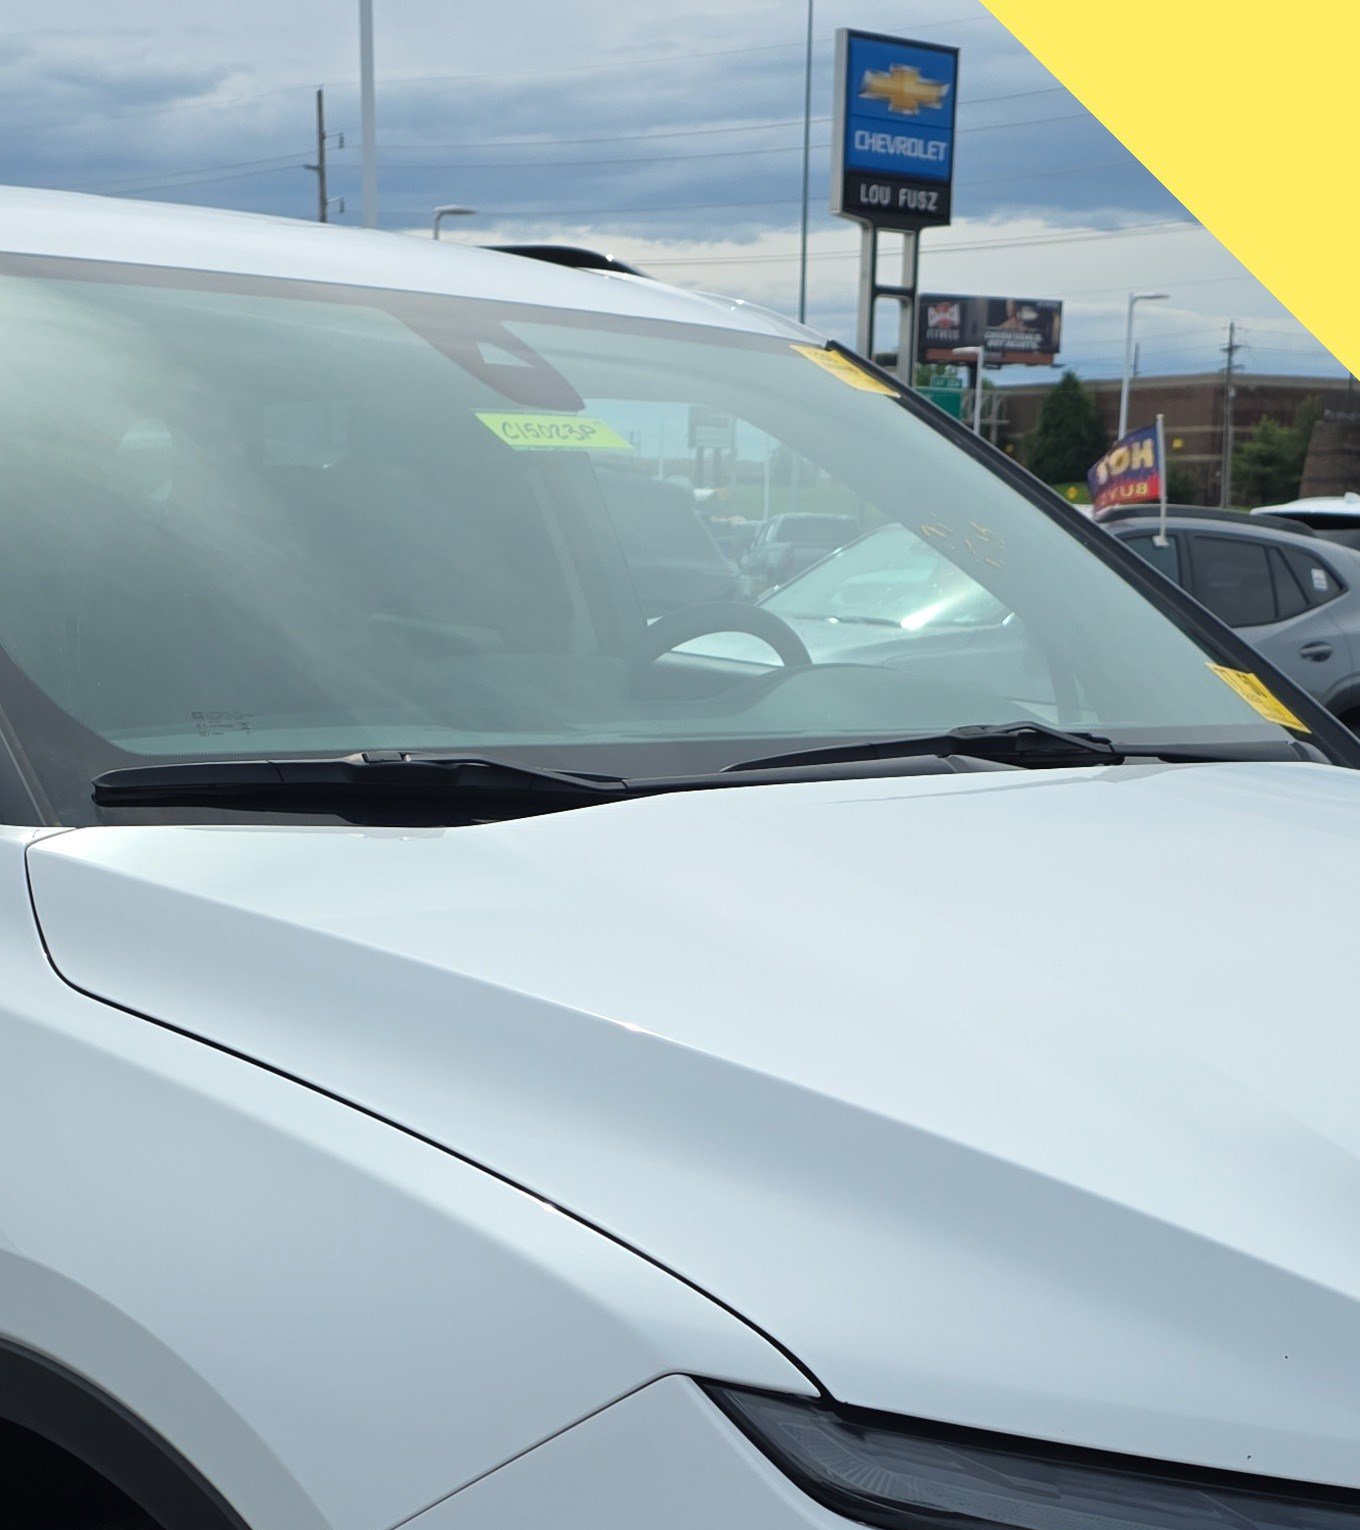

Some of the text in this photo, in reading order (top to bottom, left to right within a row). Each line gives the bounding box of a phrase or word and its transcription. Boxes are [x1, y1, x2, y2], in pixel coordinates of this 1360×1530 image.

[854, 130, 948, 162] CHEVROLET
[860, 183, 938, 211] LOU FUSZ
